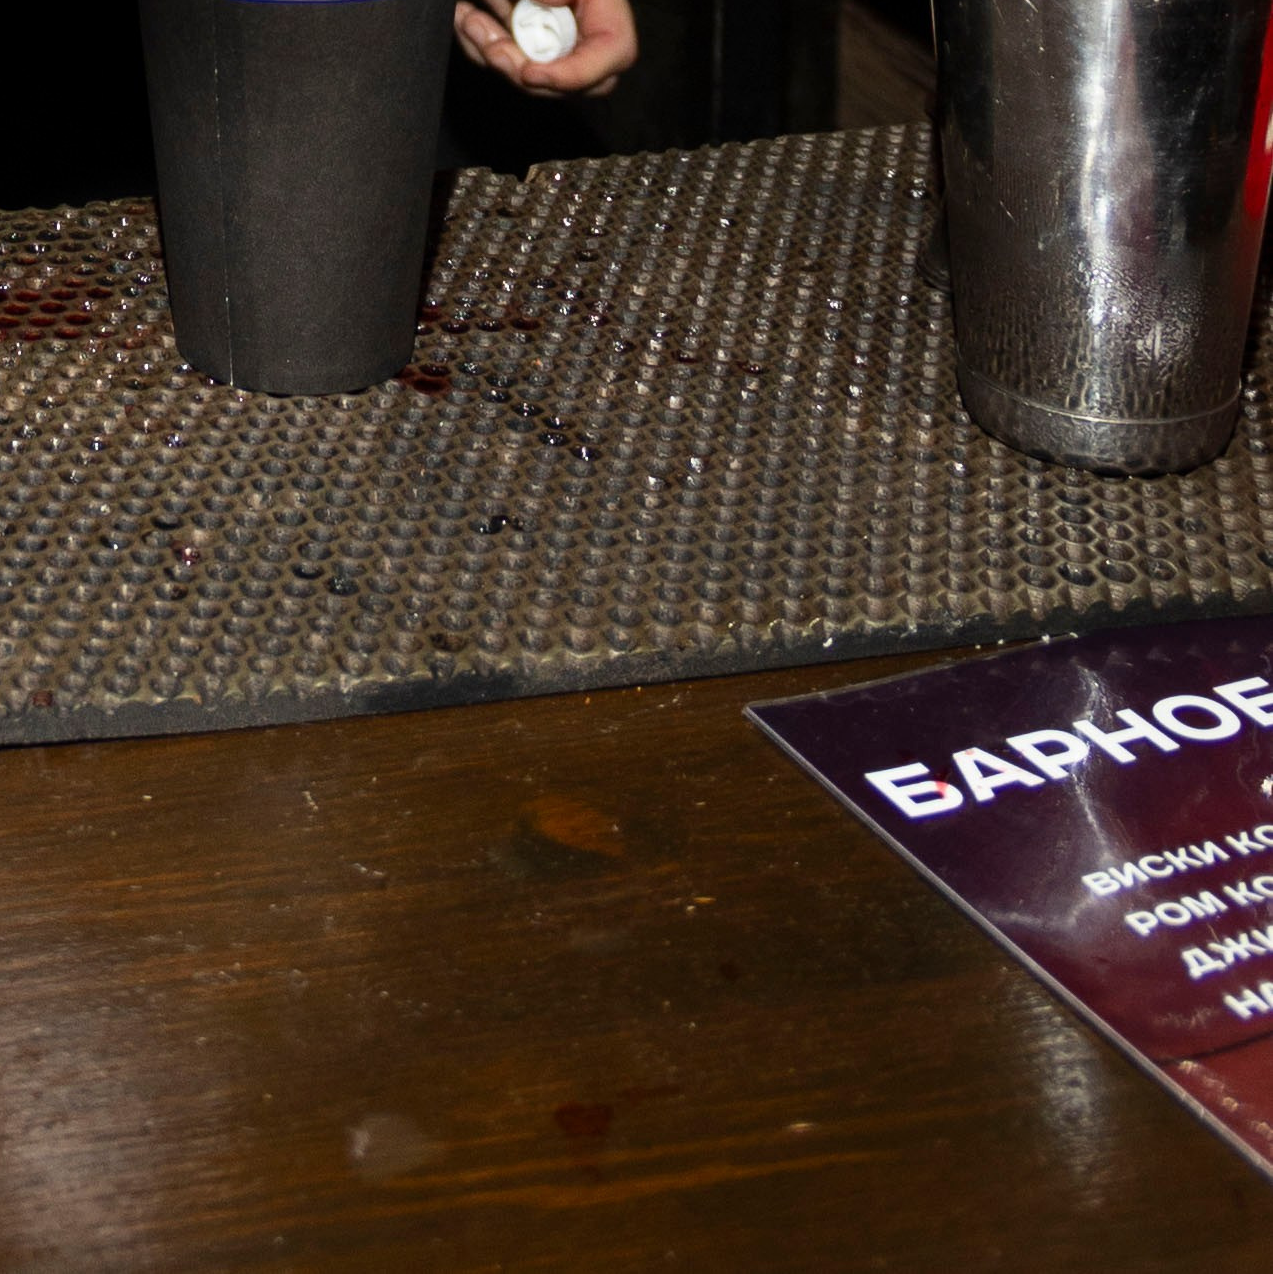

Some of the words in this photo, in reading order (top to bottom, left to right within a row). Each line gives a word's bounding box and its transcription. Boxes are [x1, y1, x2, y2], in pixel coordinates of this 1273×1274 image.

[864, 675, 1273, 820] БАРНОЕ
[1080, 840, 1231, 897] ВИСКИ
[1124, 890, 1229, 937] РОМ
